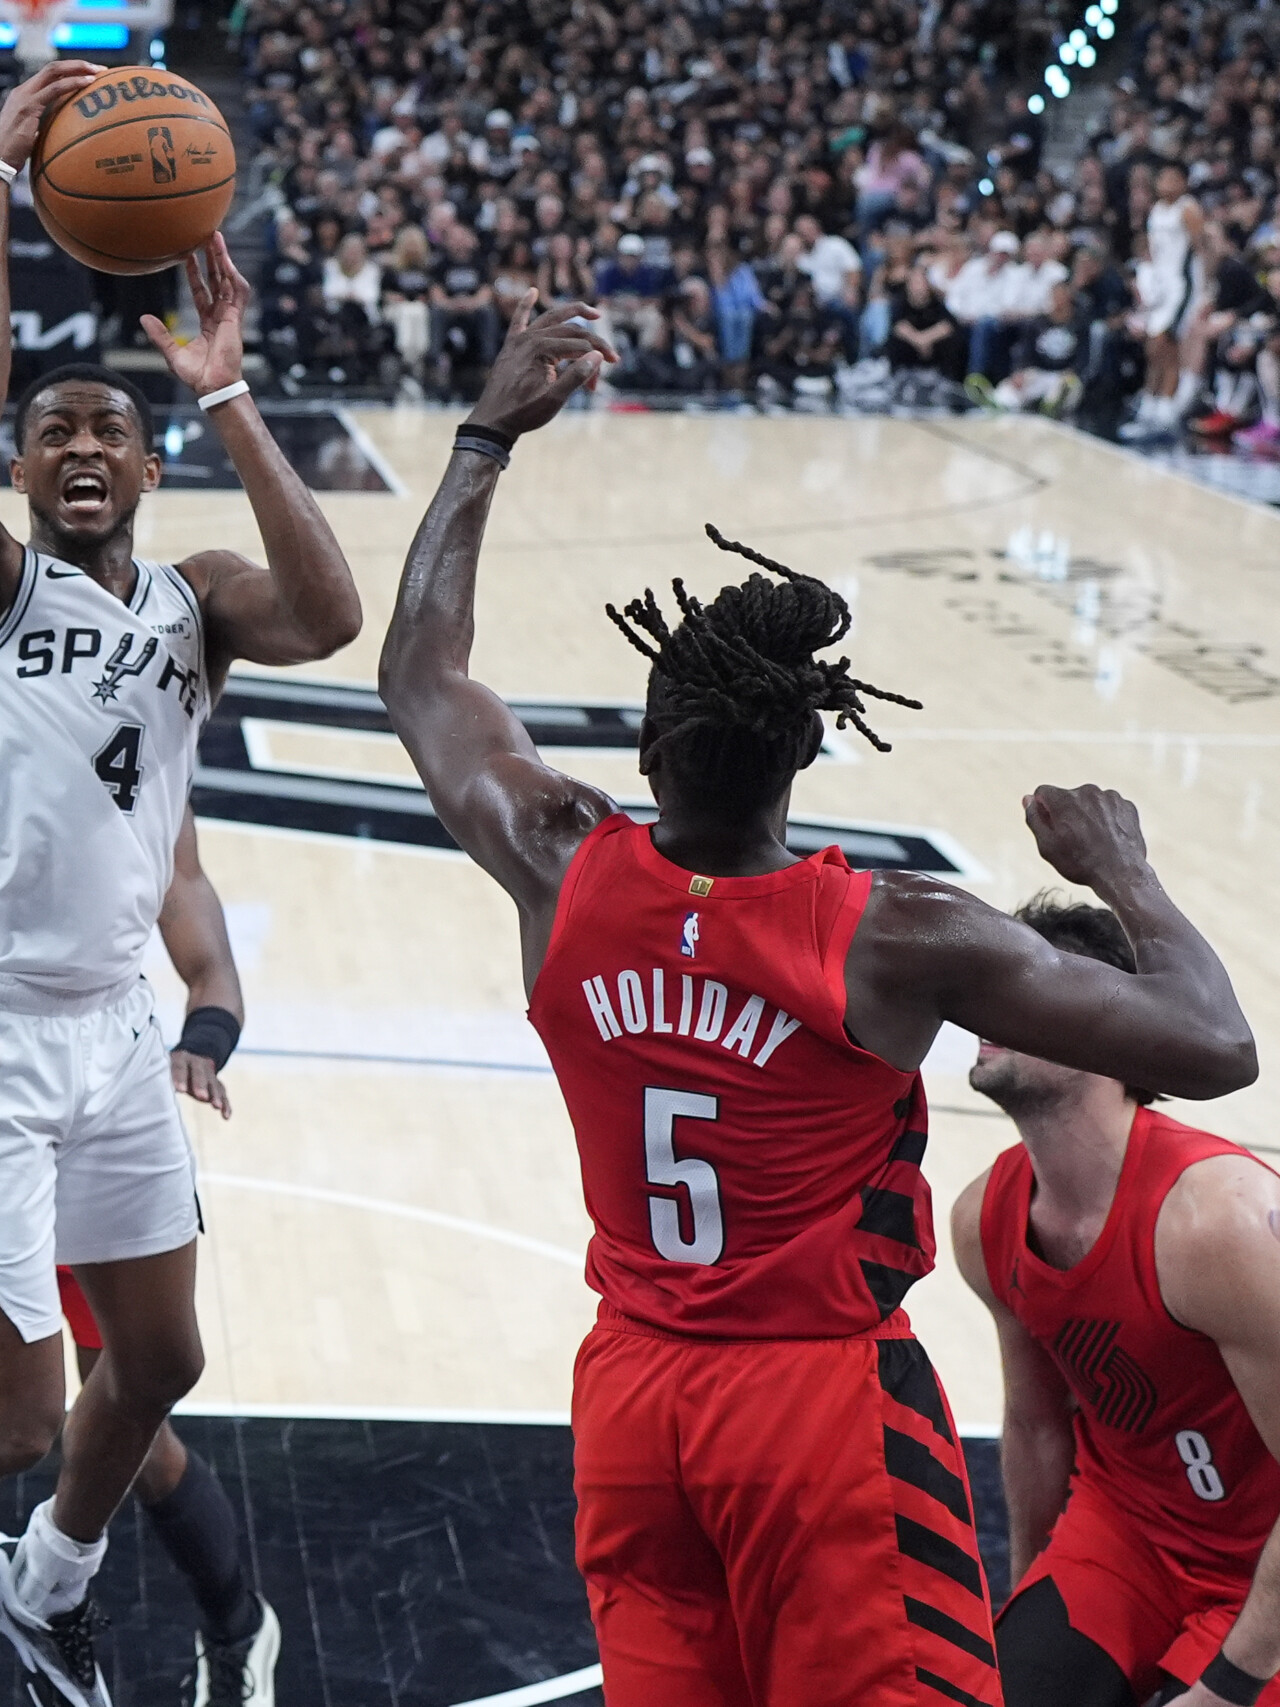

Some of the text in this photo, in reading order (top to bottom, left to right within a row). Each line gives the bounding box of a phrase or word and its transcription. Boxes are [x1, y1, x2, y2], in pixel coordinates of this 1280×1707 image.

[74, 76, 208, 118] Wilson
[90, 722, 146, 817] 4
[582, 968, 802, 1068] HOLIDAY
[642, 1084, 725, 1268] 5
[1175, 1429, 1225, 1501] 8
